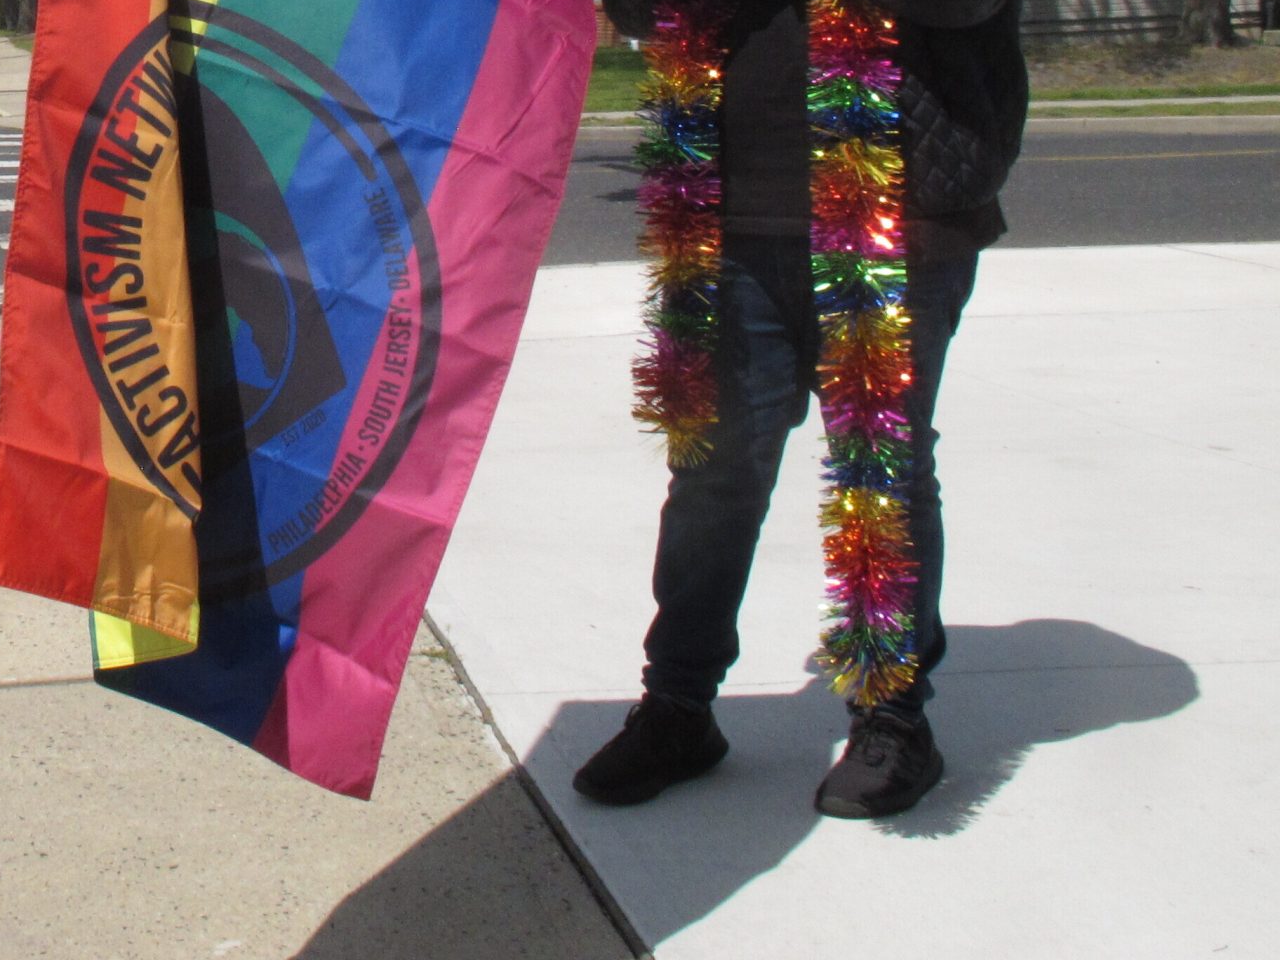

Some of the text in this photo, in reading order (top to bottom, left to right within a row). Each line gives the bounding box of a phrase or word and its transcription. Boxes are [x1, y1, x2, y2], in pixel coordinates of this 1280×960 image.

[269, 188, 413, 553] PHILADELPHIA SOUTH JERSEY DELAWARE
